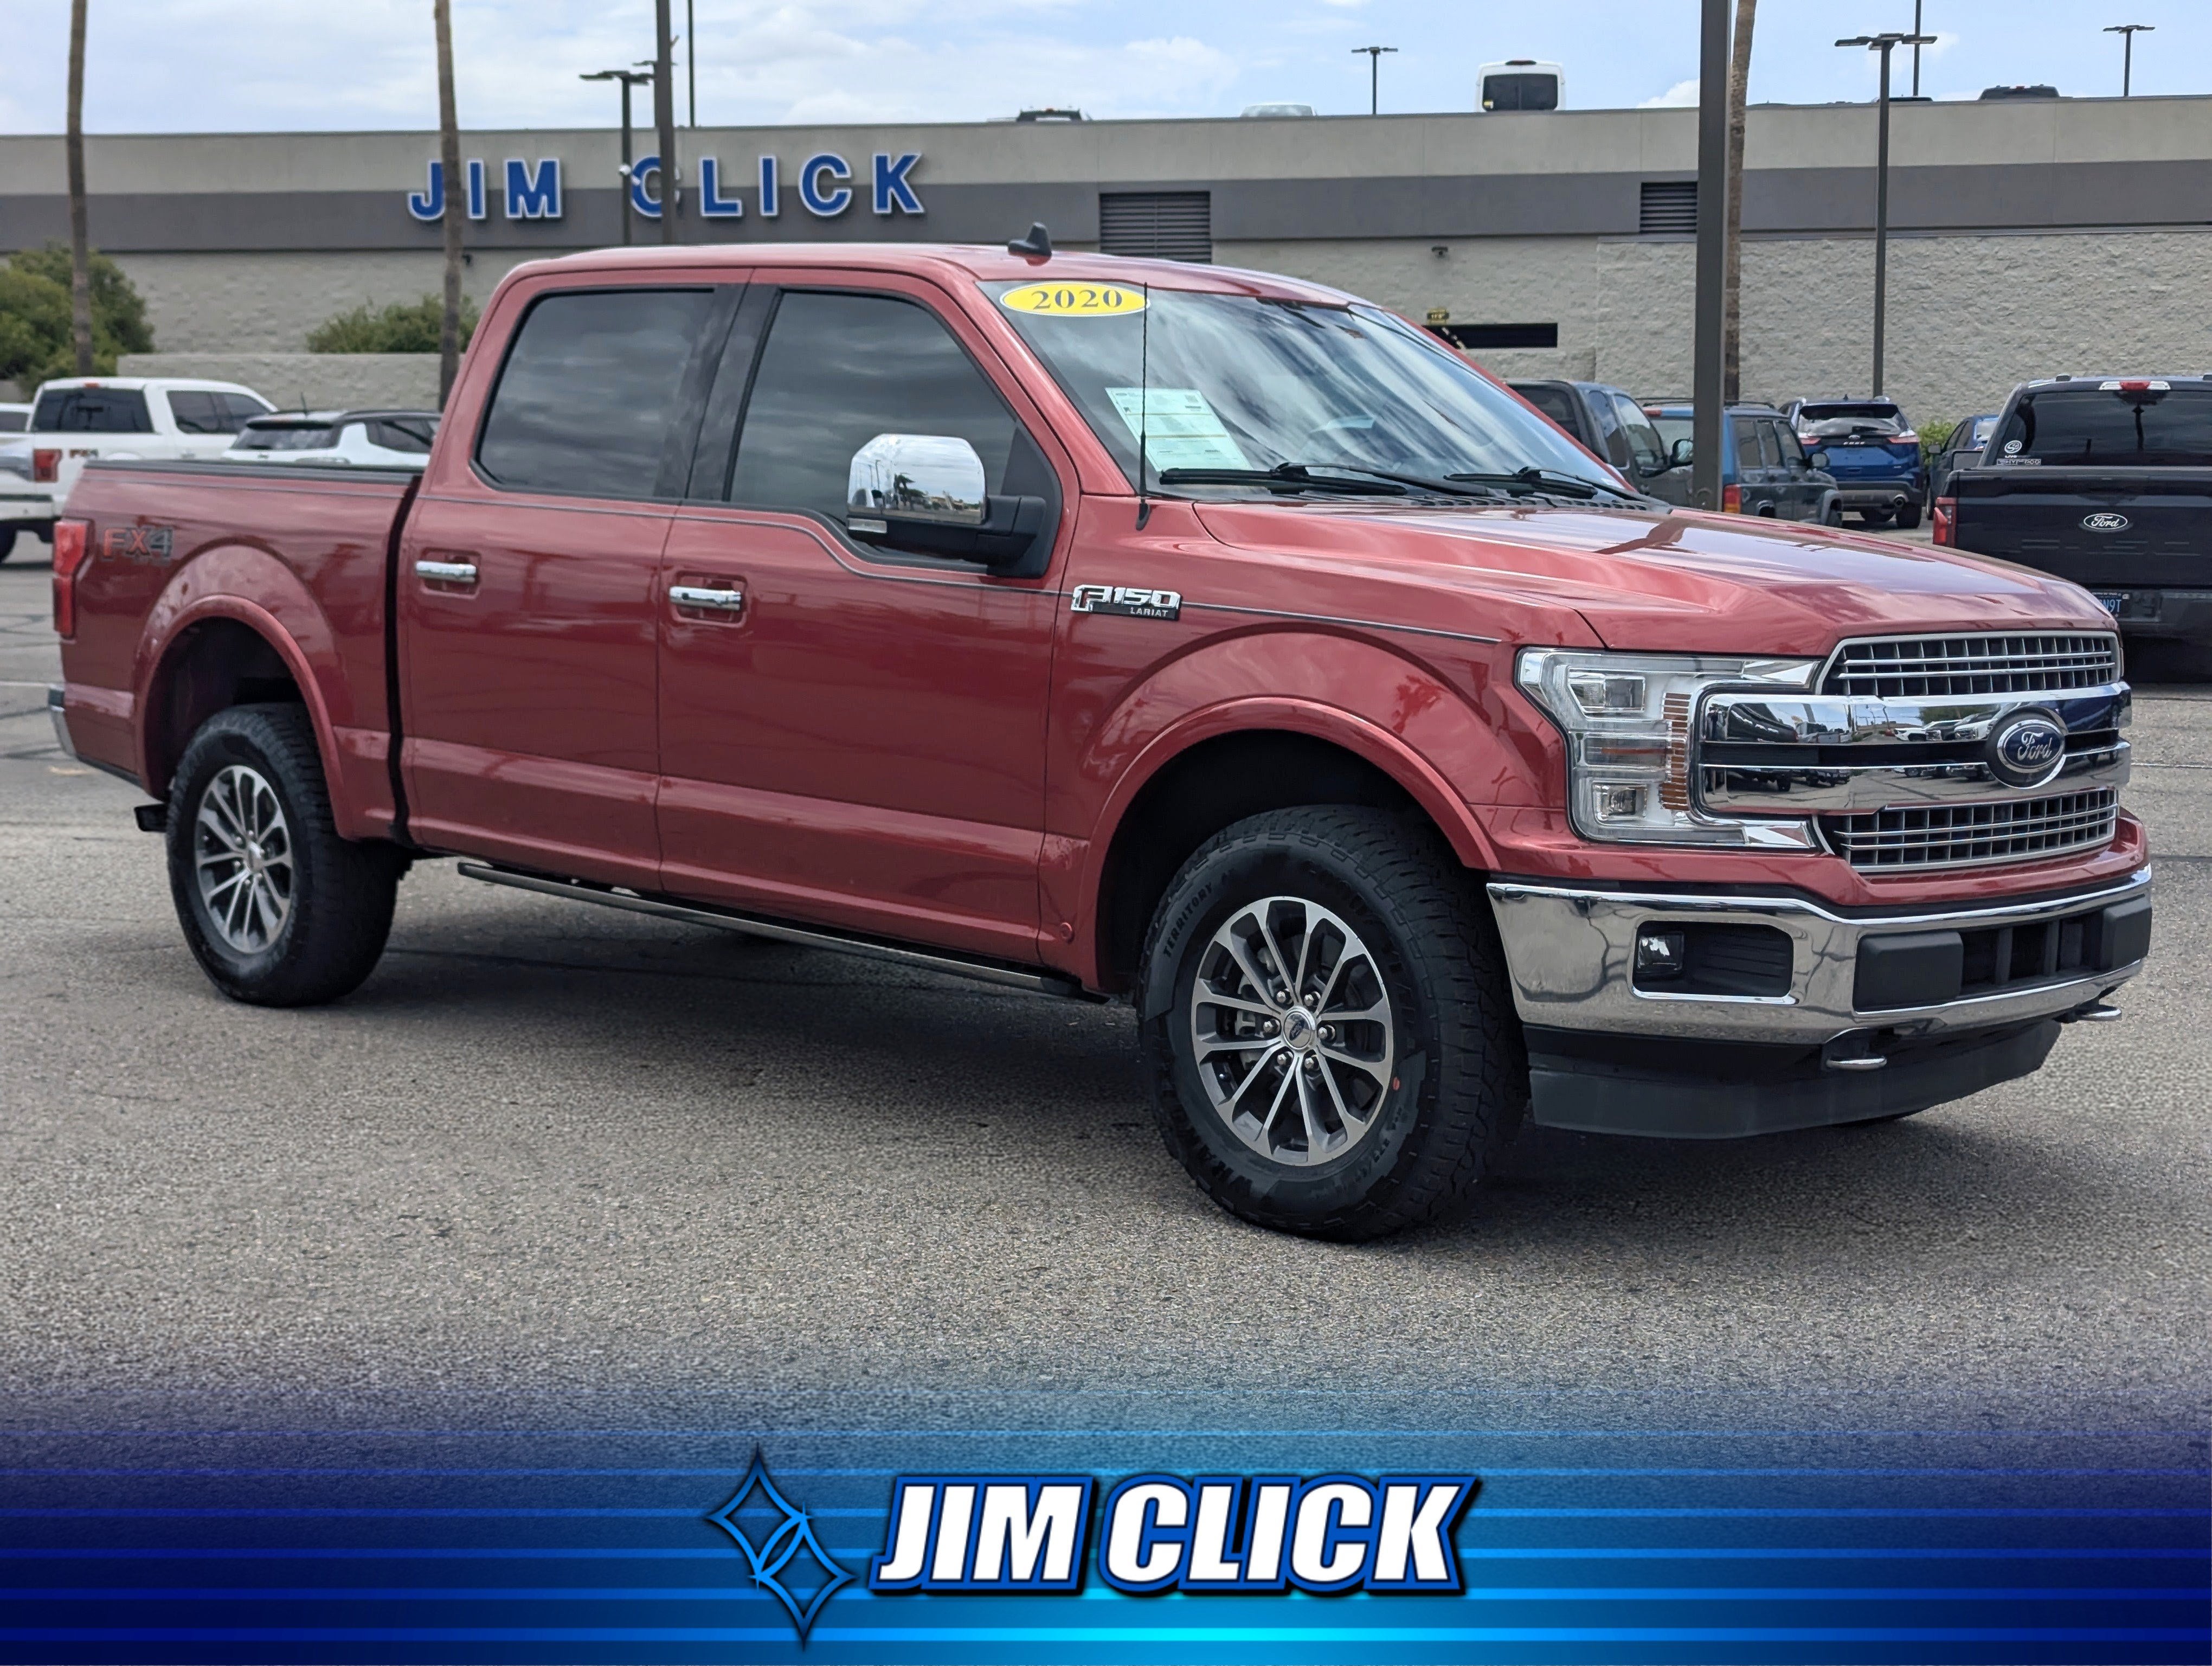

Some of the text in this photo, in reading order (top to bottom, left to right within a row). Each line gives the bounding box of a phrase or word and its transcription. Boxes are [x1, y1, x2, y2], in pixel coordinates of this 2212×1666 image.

[407, 152, 925, 220] JIM CLICK
[1031, 289, 1122, 310] 2020
[2091, 515, 2120, 527] Ford
[102, 526, 173, 558] FX4
[1130, 607, 1169, 617] LARIAT
[2017, 731, 2053, 761] Ford
[1163, 880, 1212, 958] TERRITORY
